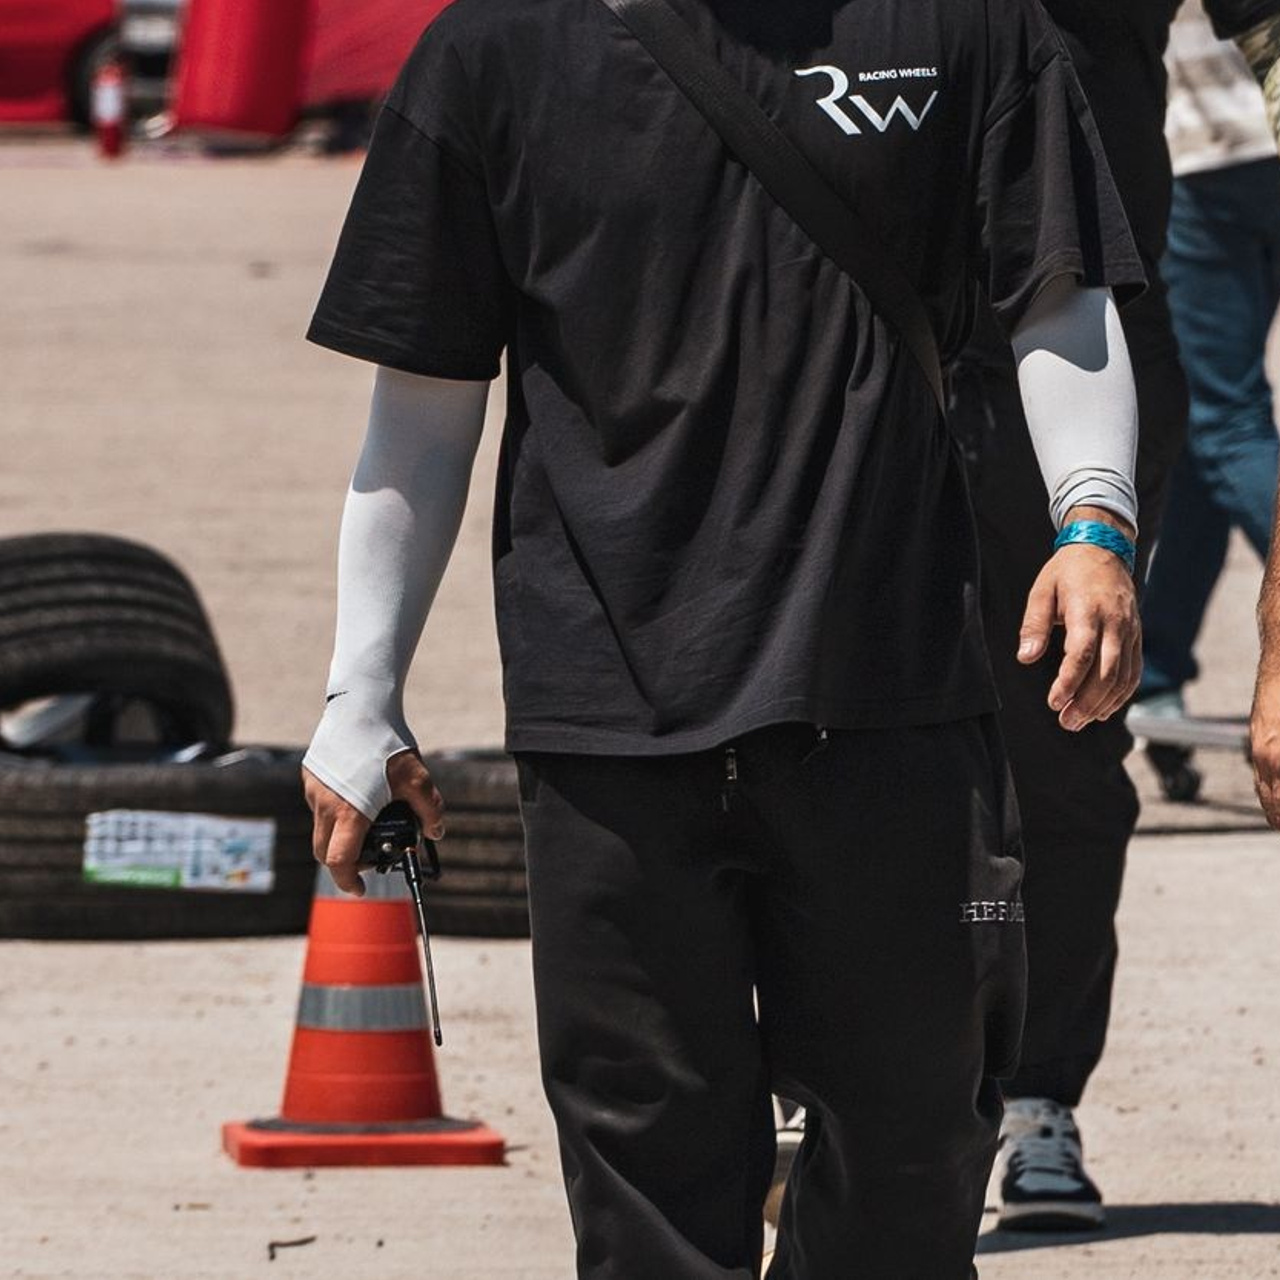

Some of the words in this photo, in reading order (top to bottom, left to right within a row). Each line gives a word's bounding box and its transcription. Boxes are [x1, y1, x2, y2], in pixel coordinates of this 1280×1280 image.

[859, 70, 897, 81] RACING
[898, 67, 937, 78] WHEELS
[794, 65, 938, 135] RW
